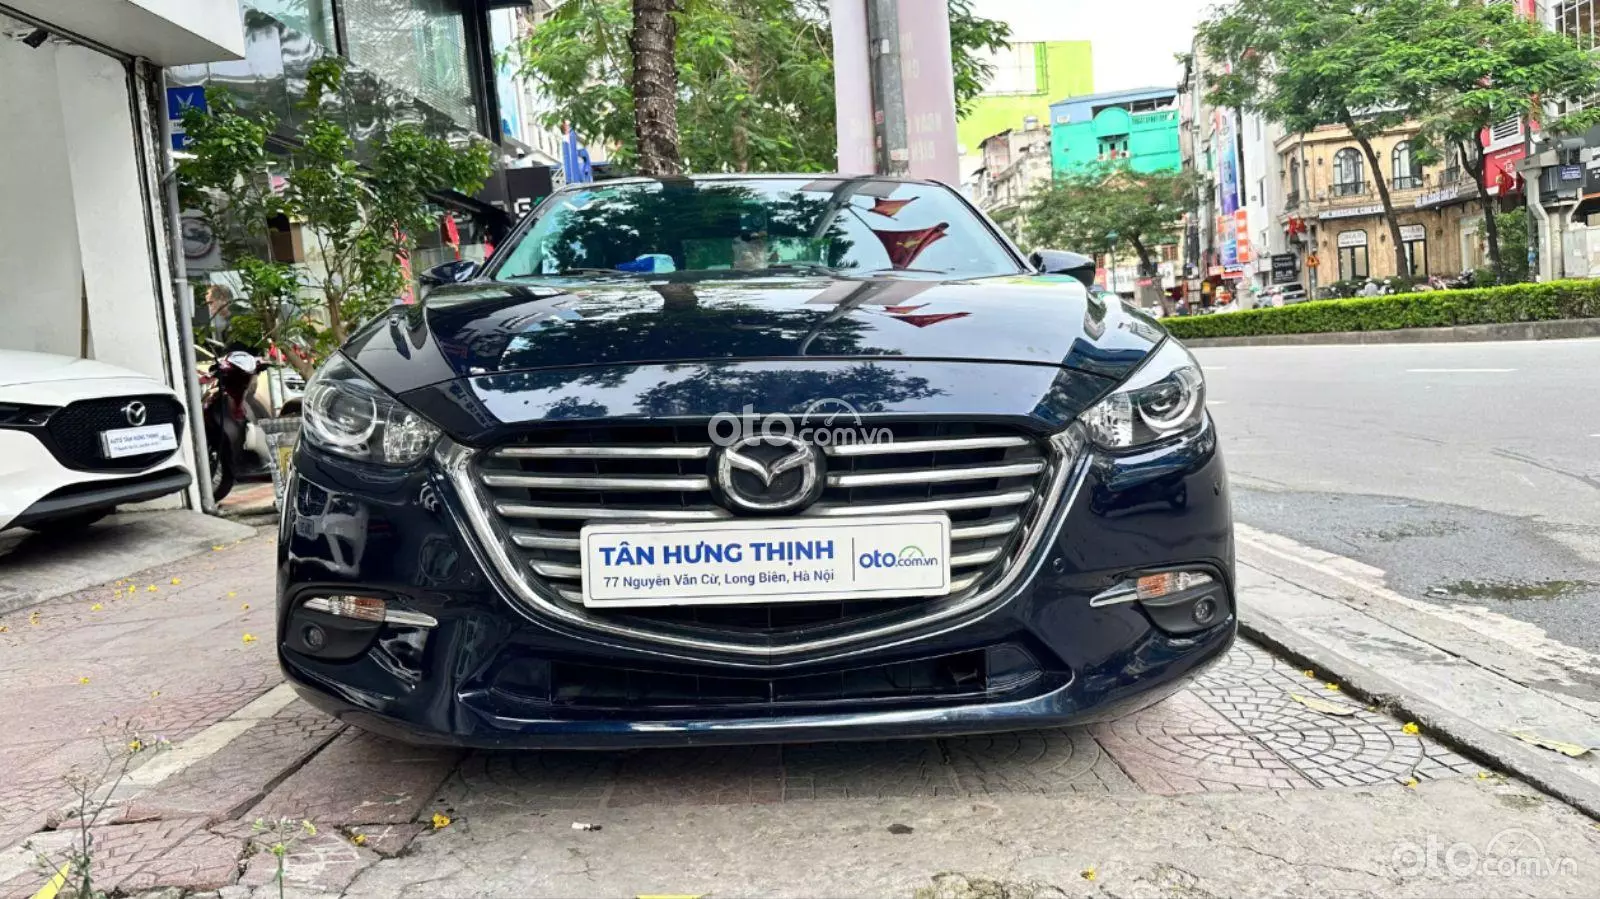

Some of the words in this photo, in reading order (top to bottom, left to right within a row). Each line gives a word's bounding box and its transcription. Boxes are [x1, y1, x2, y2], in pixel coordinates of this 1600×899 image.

[599, 541, 655, 566] TÂN
[664, 541, 743, 564] HƯNG
[749, 540, 834, 566] THỊNH
[859, 549, 938, 569] oto.com.vn
[604, 576, 619, 588] 77
[674, 572, 697, 586] Văn
[701, 572, 721, 587] Cừ,
[725, 572, 755, 586] Long
[759, 571, 789, 584] Biên,
[793, 571, 810, 582] Hà
[814, 569, 834, 582] Nội
